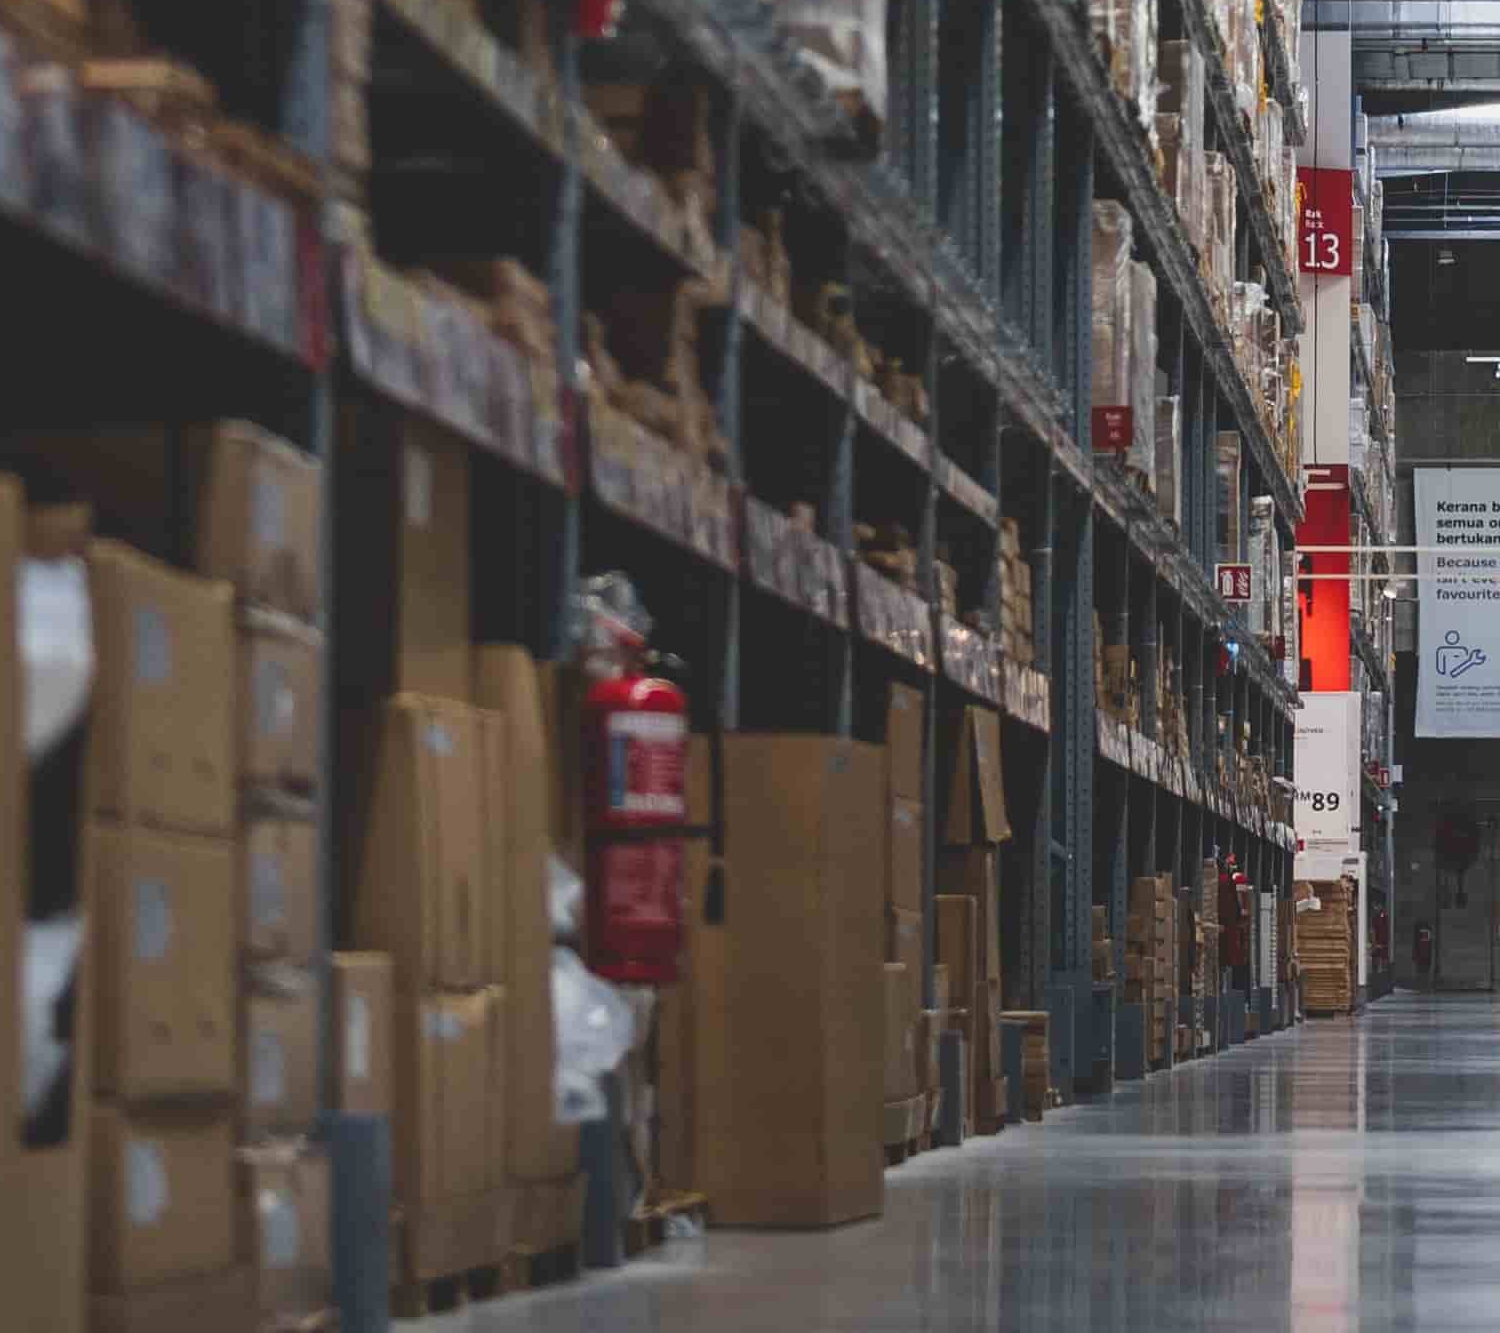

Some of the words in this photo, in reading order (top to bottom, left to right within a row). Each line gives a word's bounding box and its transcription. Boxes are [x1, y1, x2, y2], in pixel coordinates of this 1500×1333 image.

[1304, 232, 1340, 269] 13
[1436, 500, 1487, 513] Kerana
[1436, 518, 1484, 529] semua
[1436, 556, 1497, 569] Because
[1436, 587, 1500, 600] favourite
